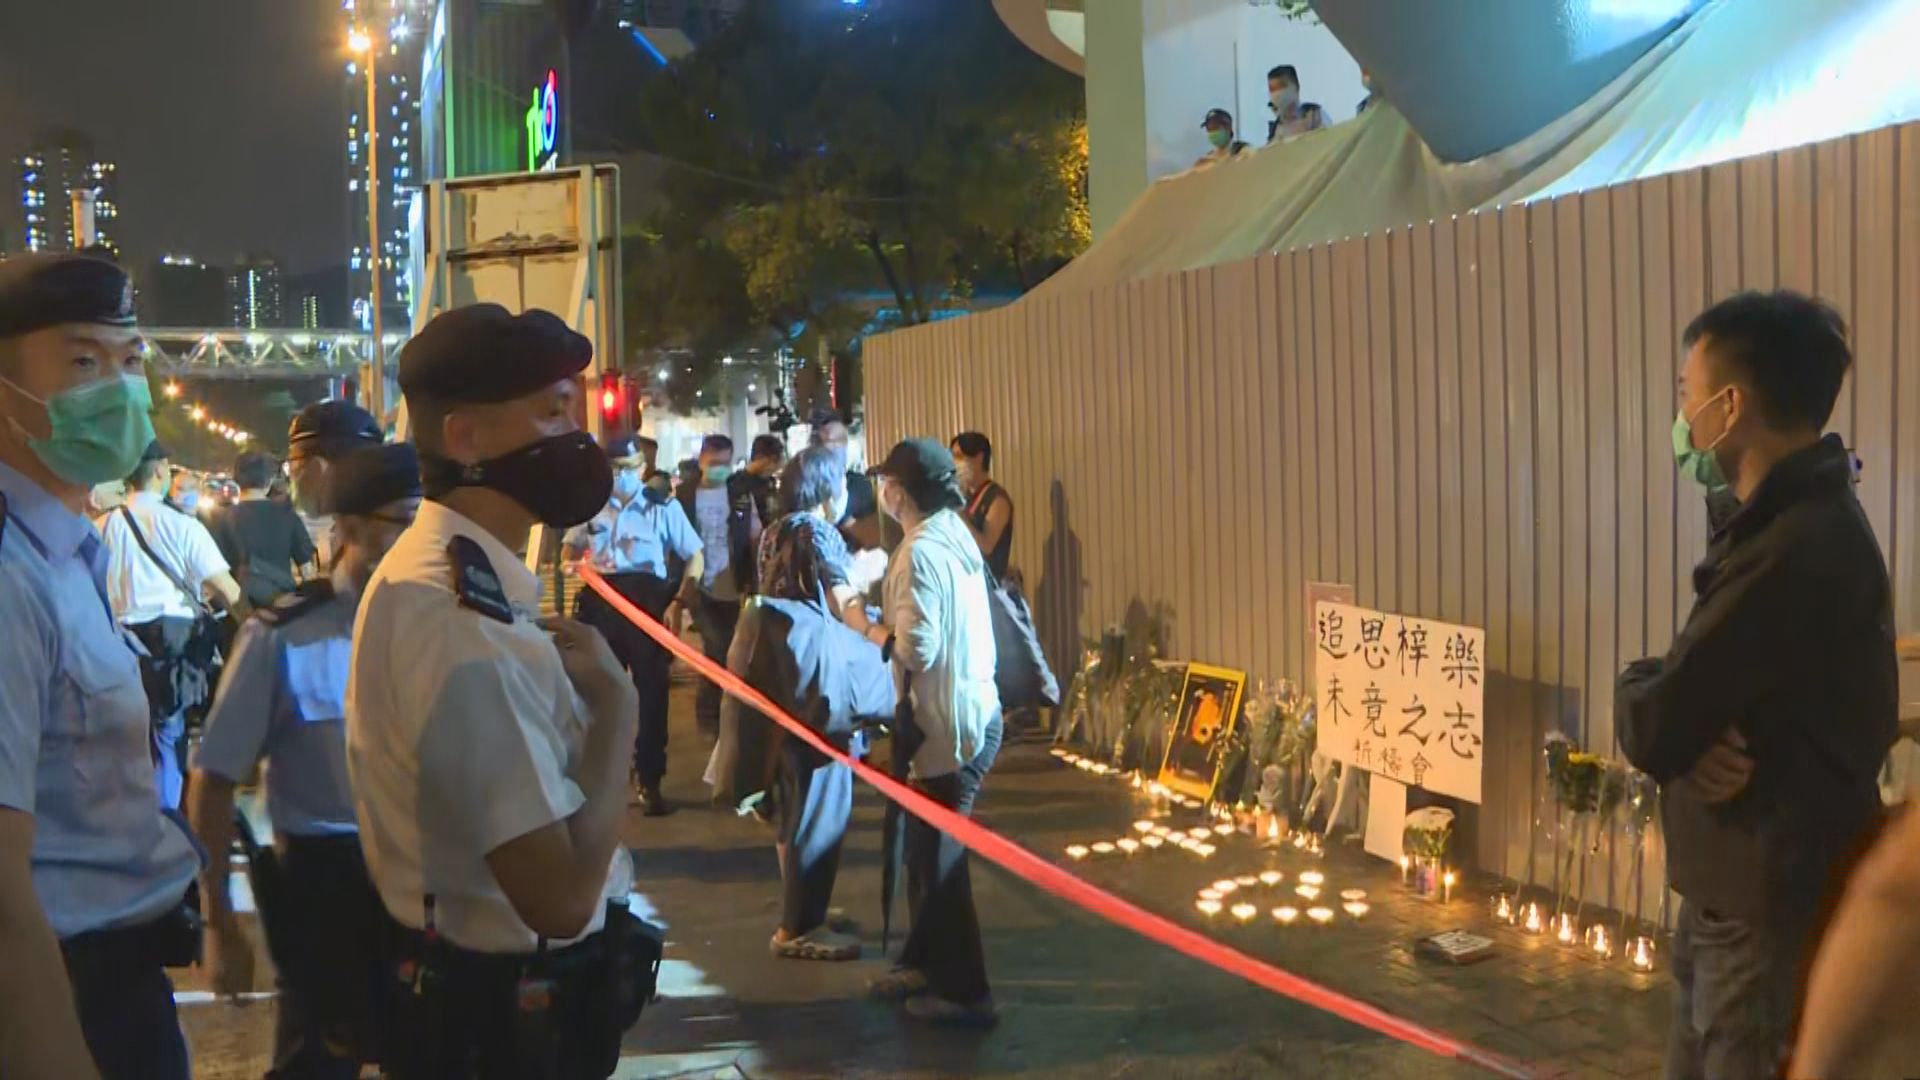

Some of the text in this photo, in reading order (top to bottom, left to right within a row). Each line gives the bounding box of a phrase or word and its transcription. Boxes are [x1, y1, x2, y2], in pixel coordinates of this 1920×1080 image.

[1319, 610, 1480, 689] 追思梓樂
[1324, 673, 1482, 759] 未竟之志
